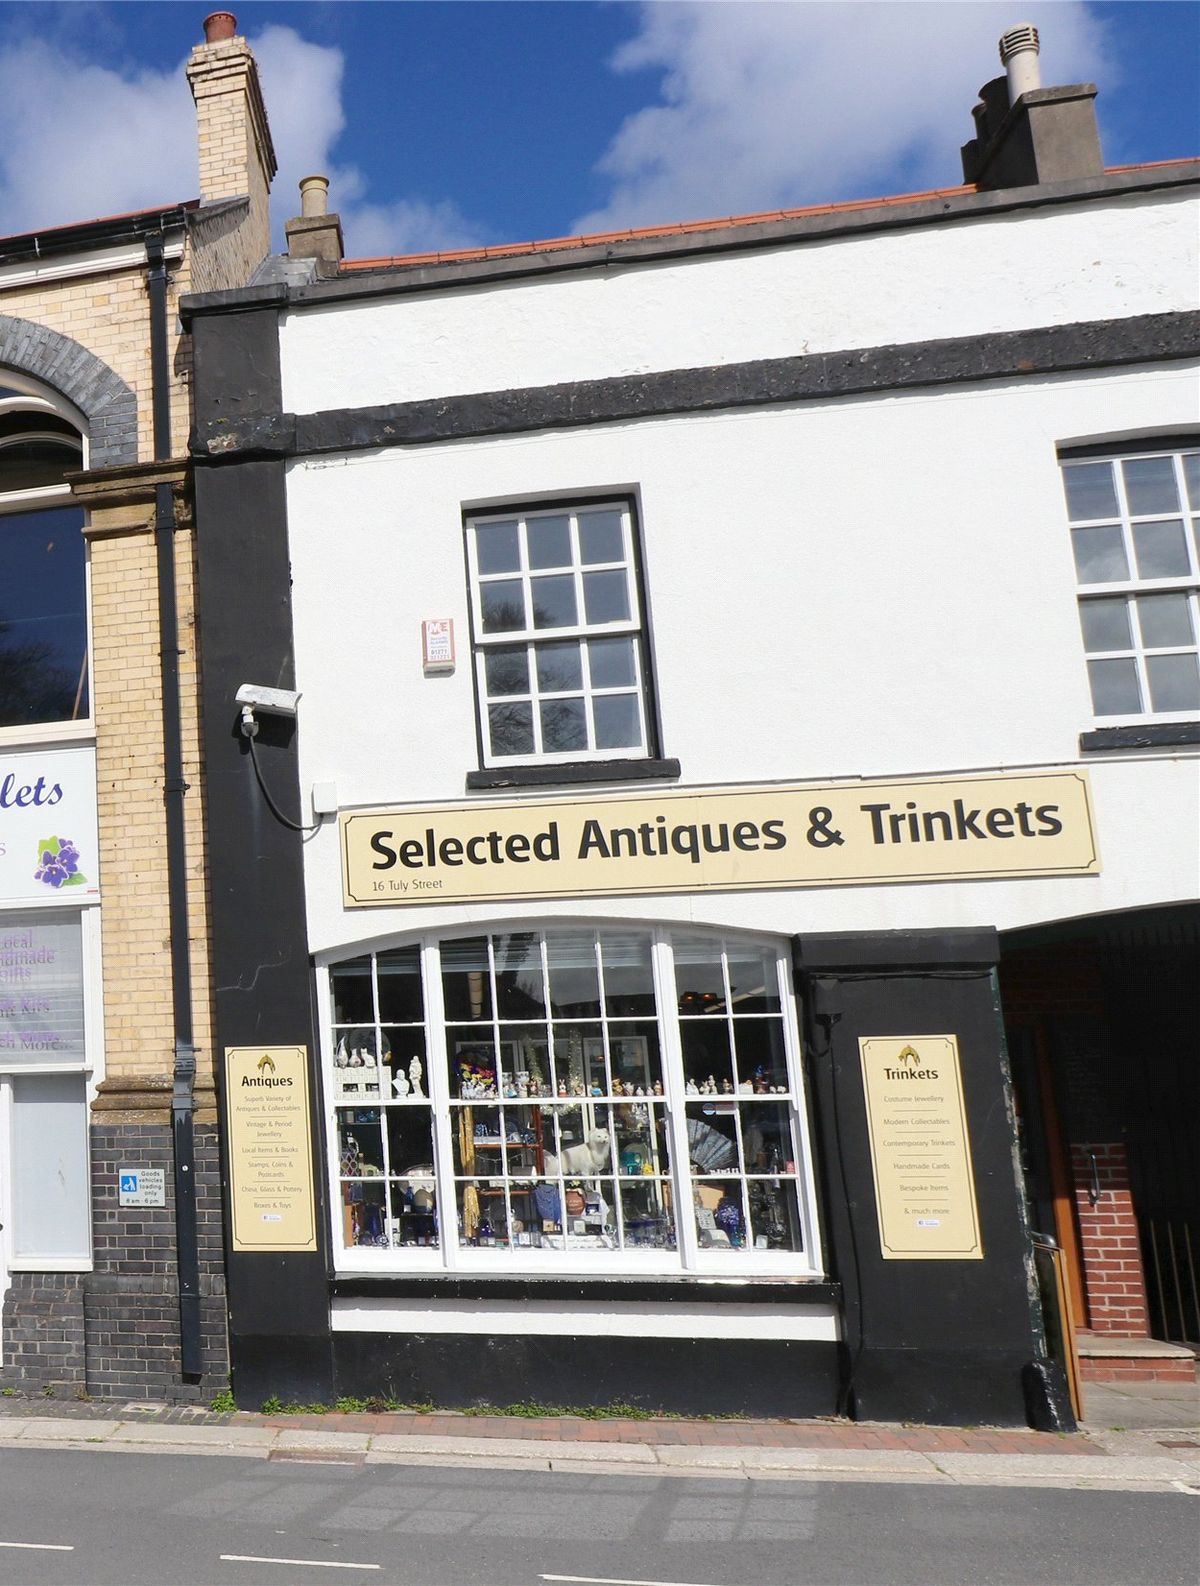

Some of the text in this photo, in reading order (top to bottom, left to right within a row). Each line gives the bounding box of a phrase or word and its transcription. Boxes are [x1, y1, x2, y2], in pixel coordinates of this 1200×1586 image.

[370, 798, 1063, 870] Selected Antiques & Trinkets
[373, 879, 443, 892] 16 Tuly Street
[883, 1067, 939, 1080] Trinkets
[241, 1075, 293, 1088] Antiques
